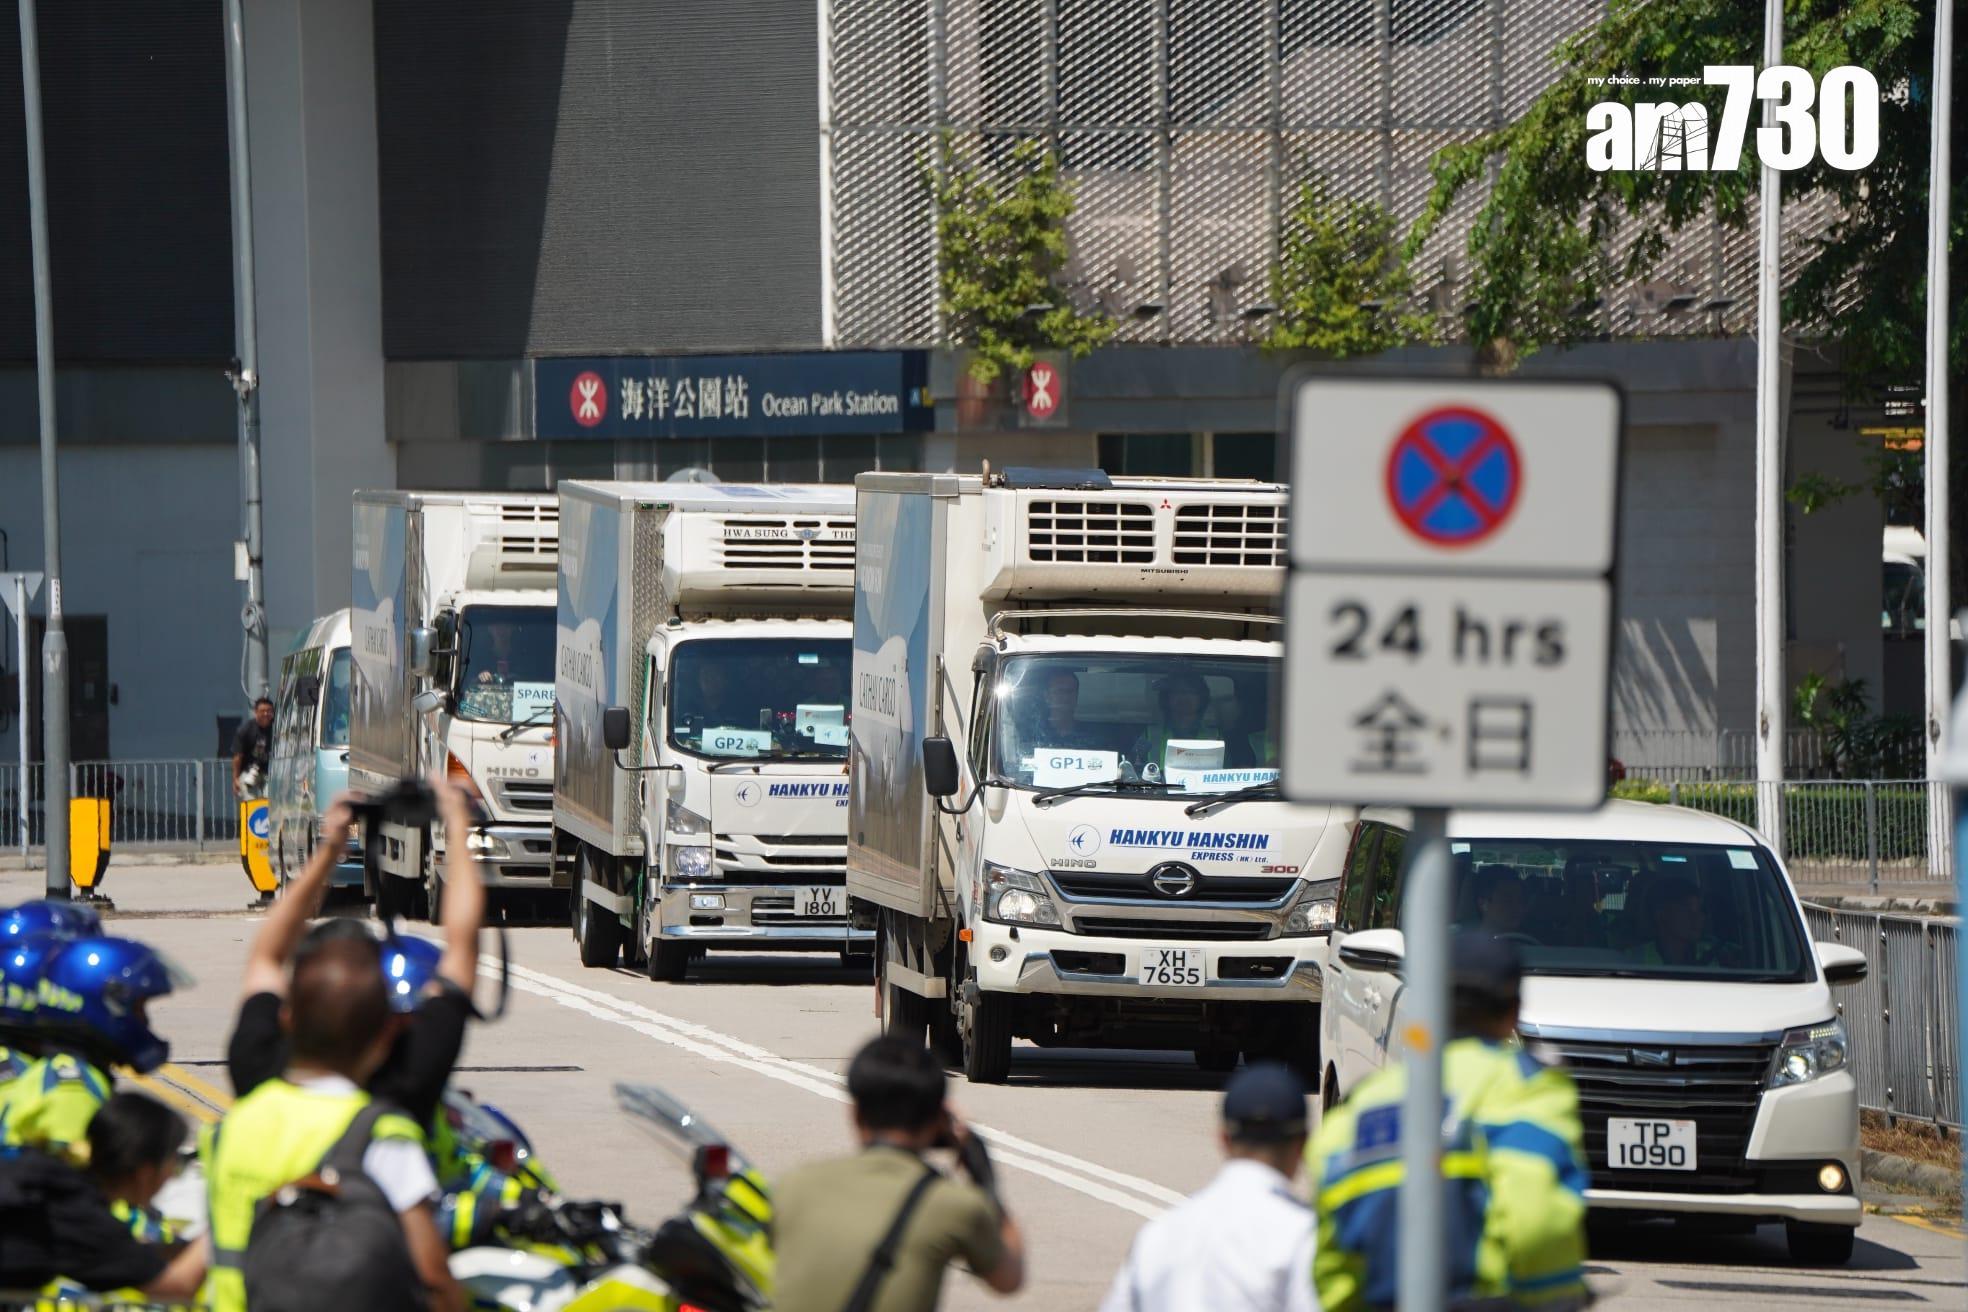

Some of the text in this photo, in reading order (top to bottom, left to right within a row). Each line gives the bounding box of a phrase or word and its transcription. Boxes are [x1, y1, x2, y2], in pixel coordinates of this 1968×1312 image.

[620, 375, 749, 421] 海洋公園站
[762, 390, 899, 417] Ocean Park Station
[723, 529, 788, 538] HWA SUNG
[1330, 599, 1566, 668] 24 hrs
[878, 677, 896, 717] CARGO
[1349, 689, 1533, 778] 全日
[714, 737, 744, 750] GP2
[1050, 757, 1084, 770] GP1
[486, 767, 539, 777] HINO
[1202, 772, 1250, 783] HANKYU
[769, 783, 830, 796] HANKYU
[1109, 829, 1269, 850] HANKYU HANSHIN
[1050, 858, 1097, 868] HINO
[1191, 851, 1234, 862] EXPRESS
[1260, 865, 1299, 874] 300
[810, 888, 831, 901] YV
[805, 901, 835, 914] 1801
[1158, 950, 1186, 967] XH
[1144, 966, 1200, 985] 7655
[1634, 1122, 1670, 1144] TP
[1620, 1143, 1685, 1167] 1090
